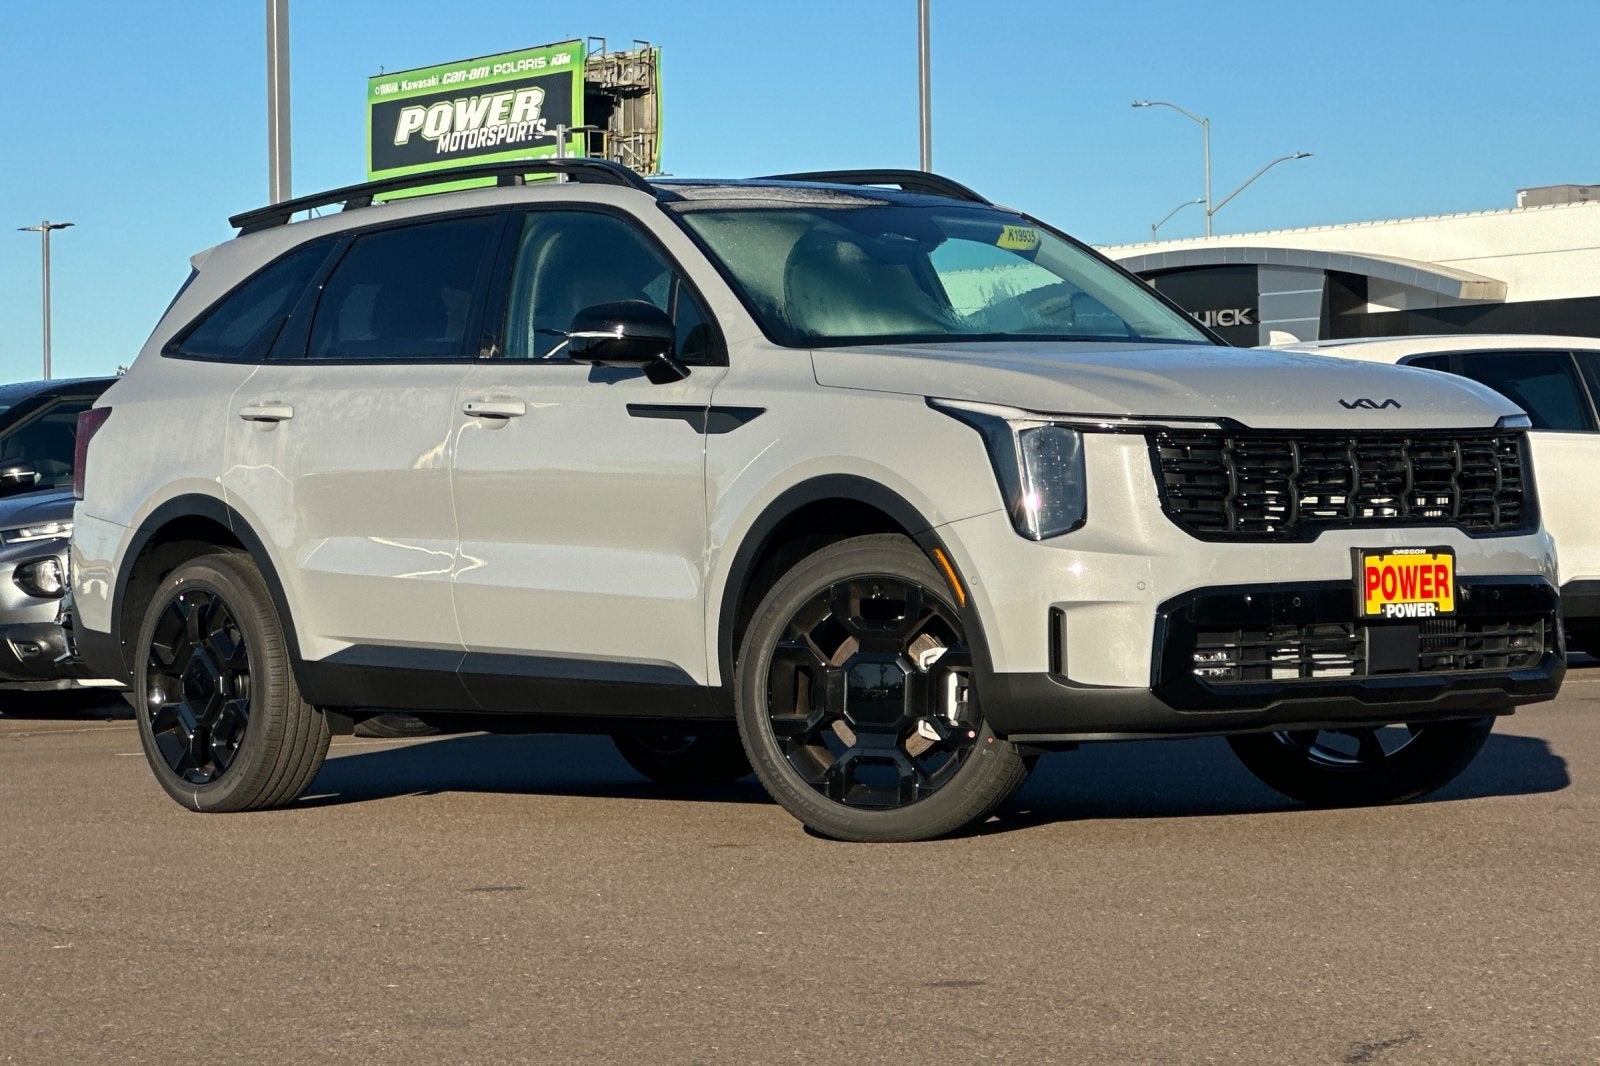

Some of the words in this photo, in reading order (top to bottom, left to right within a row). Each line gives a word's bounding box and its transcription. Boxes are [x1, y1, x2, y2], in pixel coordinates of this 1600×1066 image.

[401, 75, 439, 92] Kawasaki
[493, 56, 546, 76] POLARIS
[550, 52, 571, 67] KTM
[394, 86, 545, 147] POWER
[436, 118, 547, 154] MOTORSPORTS
[1007, 228, 1036, 243] K19935
[1187, 307, 1253, 328] UICK
[1392, 548, 1427, 556] OREGON
[1365, 564, 1450, 601] POWER
[1385, 602, 1437, 618] POWER
